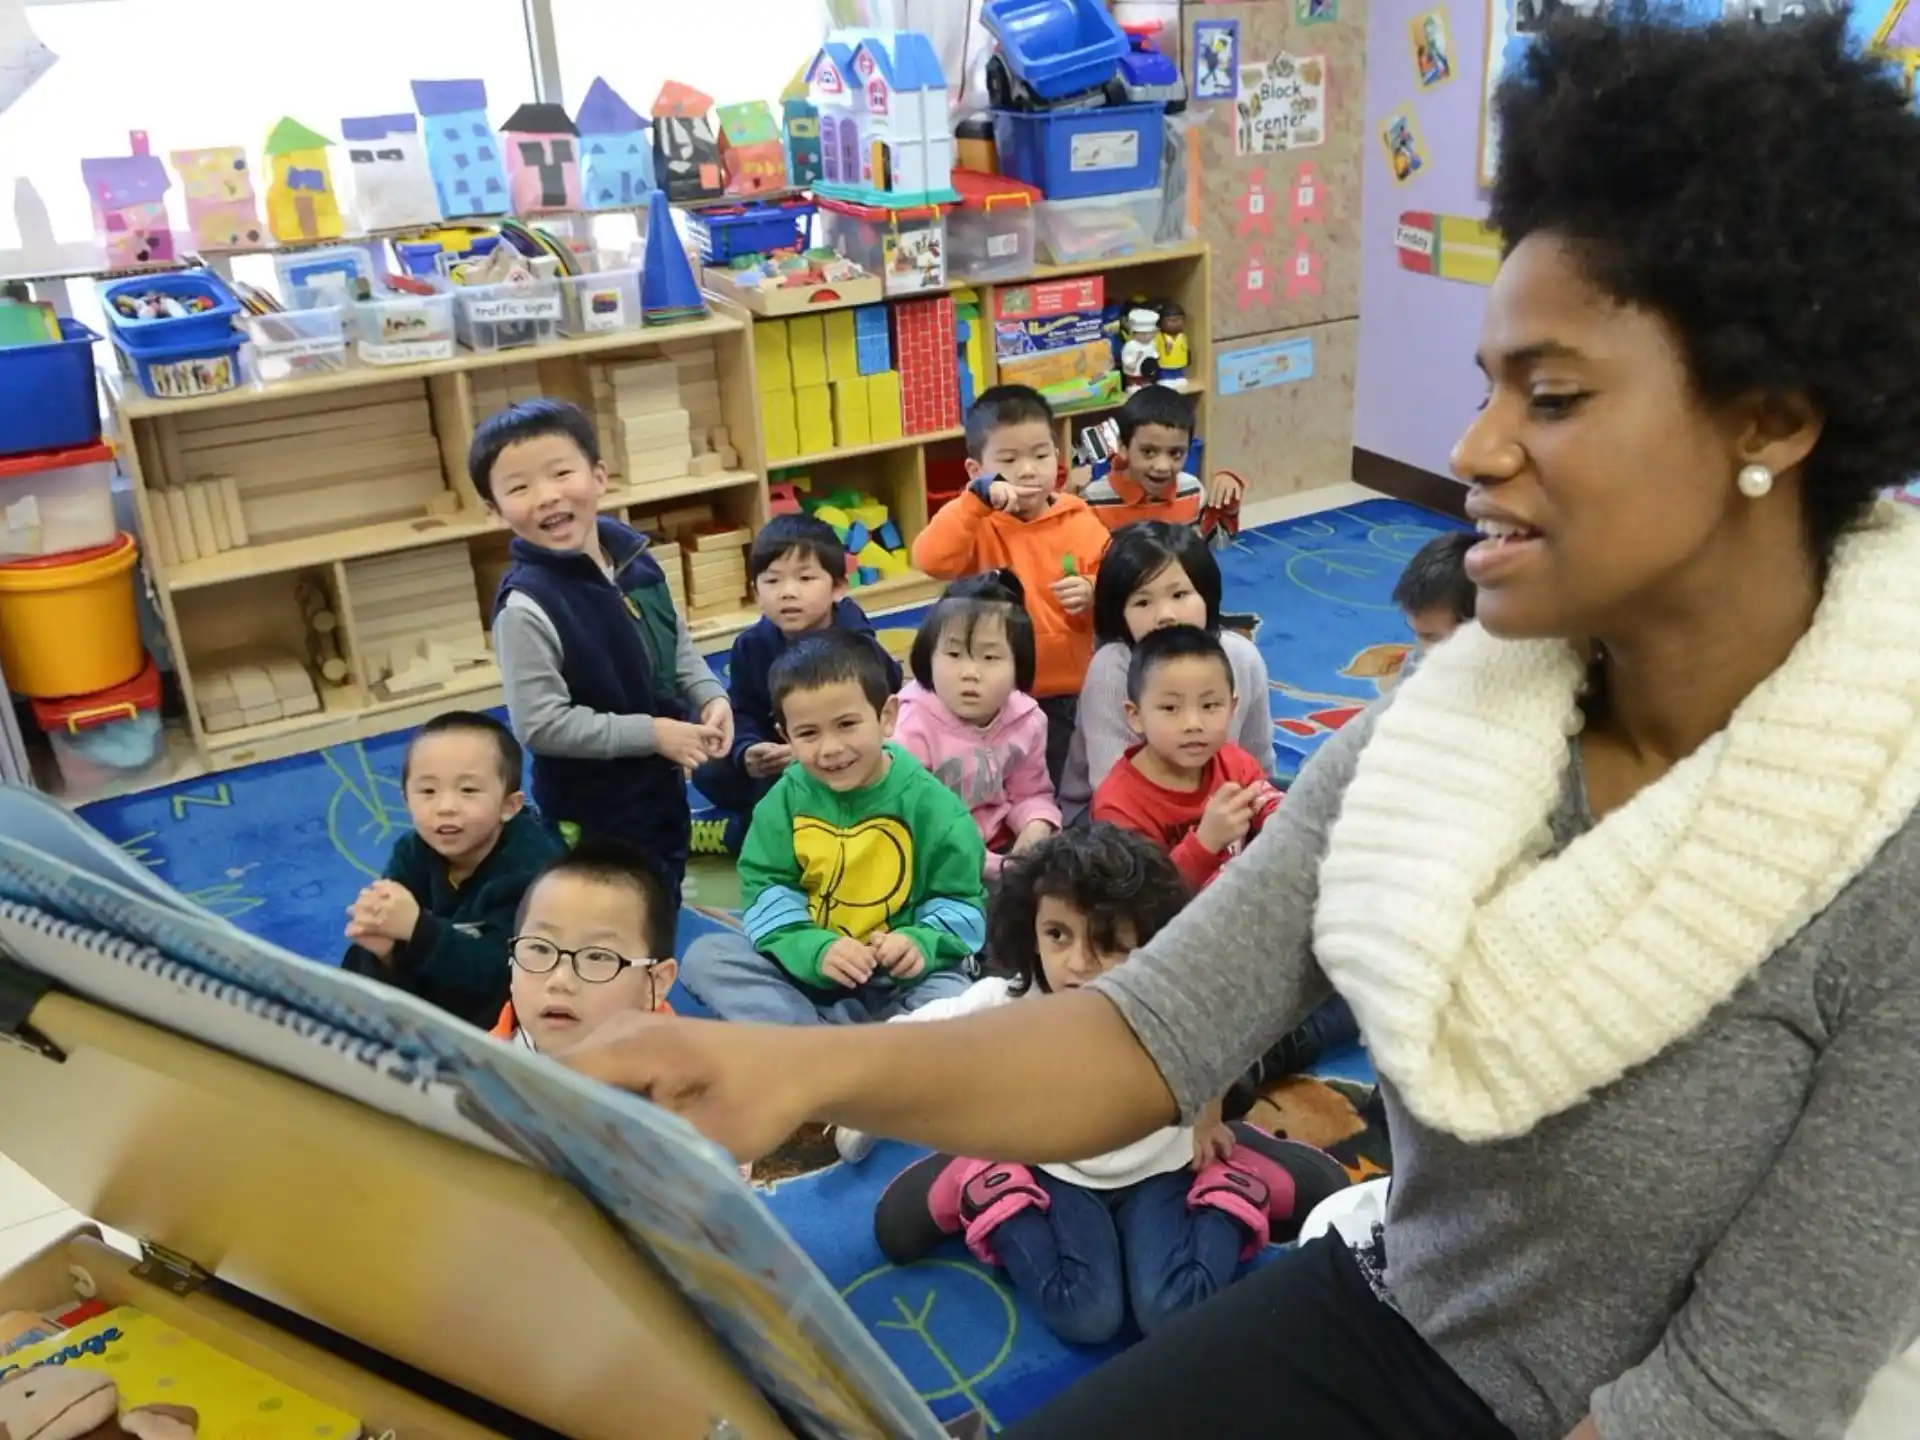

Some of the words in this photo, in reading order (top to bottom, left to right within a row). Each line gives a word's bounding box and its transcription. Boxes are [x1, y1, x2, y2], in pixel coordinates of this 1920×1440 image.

[1261, 80, 1302, 101] Block
[1254, 112, 1306, 133] center
[1396, 226, 1429, 252] Friday
[475, 301, 518, 318] traffic
